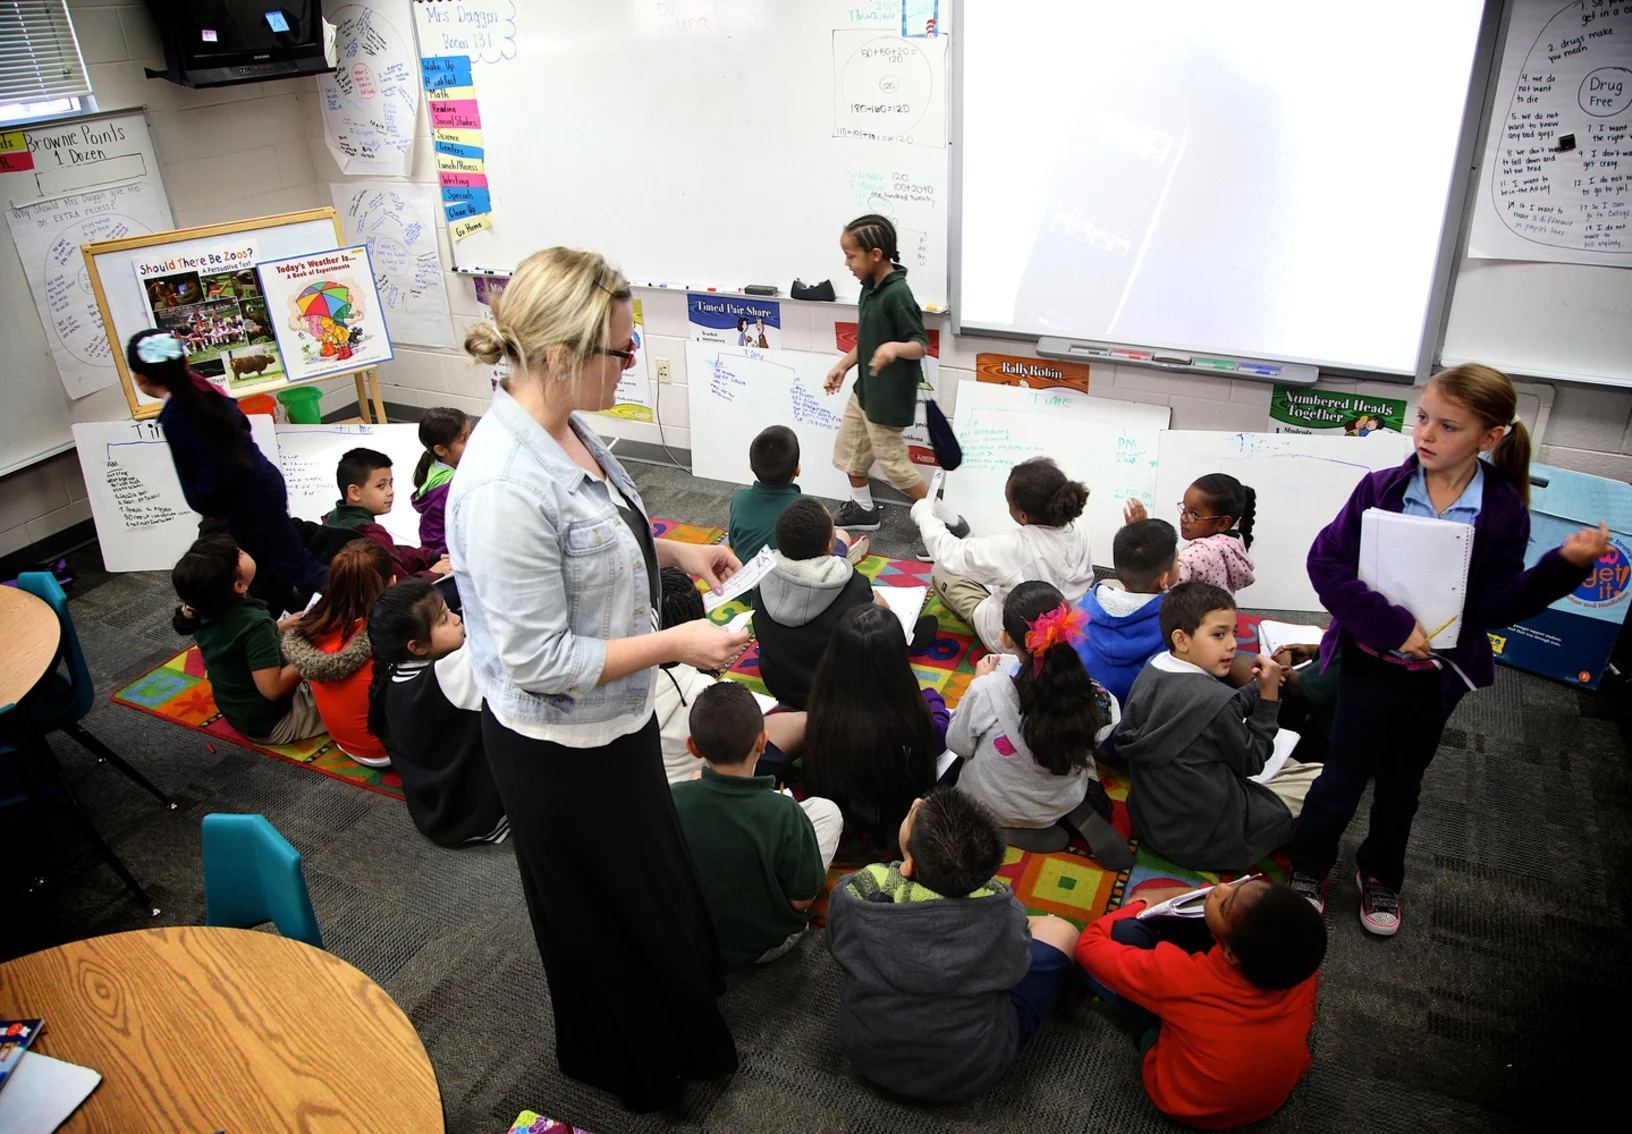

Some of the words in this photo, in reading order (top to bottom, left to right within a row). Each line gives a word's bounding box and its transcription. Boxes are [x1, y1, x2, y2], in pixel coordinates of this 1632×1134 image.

[426, 6, 450, 23] Mrs
[1582, 11, 1596, 26] get
[1600, 8, 1609, 18] in
[442, 33, 468, 49] Room
[473, 33, 492, 49] 131
[1561, 35, 1585, 49] drugs
[1589, 28, 1614, 39] make
[1548, 54, 1561, 64] you
[1564, 46, 1588, 57] mean
[424, 61, 441, 71] Wake
[445, 60, 455, 72] Up
[1547, 74, 1556, 82] do
[883, 82, 896, 90] 120
[1590, 76, 1623, 96] Drug
[429, 88, 449, 99] Math
[1527, 95, 1538, 103] die
[1590, 96, 1612, 107] Free
[432, 103, 456, 113] Reading
[435, 115, 454, 126] Social
[455, 116, 477, 126] Studies
[1598, 124, 1603, 132] I
[23, 131, 78, 152] Brownie
[81, 123, 125, 144] Points
[437, 130, 459, 142] Science
[1508, 133, 1520, 141] any
[1538, 131, 1554, 141] guys
[1593, 134, 1603, 142] the
[1607, 134, 1624, 144] right
[440, 142, 464, 155] Centers
[1602, 148, 1620, 157] don't
[54, 150, 64, 166] 1
[69, 149, 106, 164] Dozen
[1583, 160, 1595, 171] get
[442, 174, 470, 187] Writing
[892, 172, 908, 182] 120
[1588, 177, 1595, 186] I
[447, 190, 474, 202] Specials
[1594, 187, 1602, 197] go
[12, 208, 30, 220] Why
[34, 200, 58, 215] Should
[65, 196, 78, 204] Mrs
[81, 191, 106, 207] Duggin
[110, 189, 125, 201] give
[885, 192, 907, 201] hundred
[910, 194, 936, 208] twenty
[37, 219, 49, 228] an
[53, 211, 81, 223] EXTRA
[84, 203, 116, 218] recess?
[1513, 211, 1528, 220] make
[1539, 216, 1573, 226] difference
[456, 228, 465, 237] Go
[465, 221, 482, 231] Home
[1550, 226, 1565, 237] lives
[140, 261, 176, 275] Should
[177, 257, 207, 268] There
[208, 254, 222, 265] Be
[224, 248, 253, 262] Zoos?
[208, 264, 238, 273] Persuasive
[239, 261, 251, 269] Text
[276, 262, 305, 274] Today's
[307, 257, 339, 268] Weather
[316, 263, 350, 274] Experiments
[696, 301, 725, 312] Timed
[726, 302, 745, 315] Pair
[746, 305, 772, 318] Share
[1284, 390, 1349, 409] Numbered
[1353, 399, 1393, 416] Heads
[1287, 404, 1344, 423] Together
[1118, 437, 1137, 450] PM
[1598, 591, 1630, 608] Nonfiction
[1534, 635, 1550, 643] through
